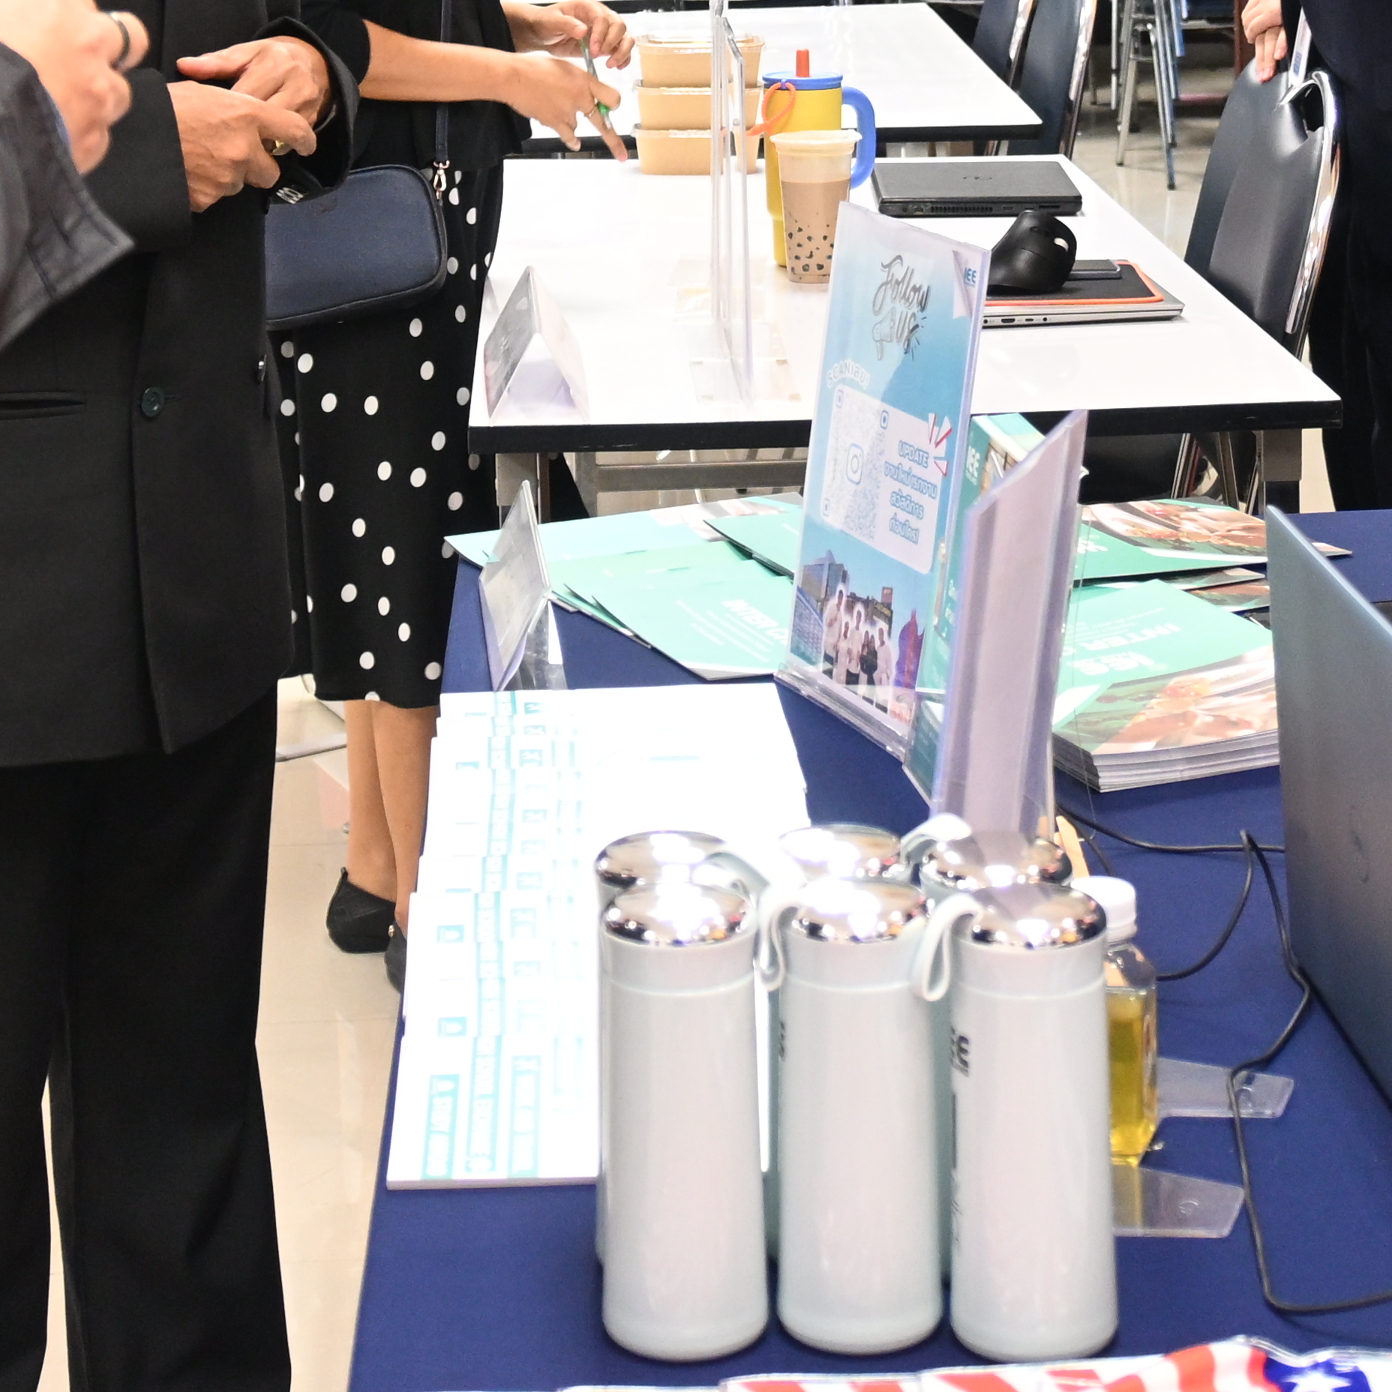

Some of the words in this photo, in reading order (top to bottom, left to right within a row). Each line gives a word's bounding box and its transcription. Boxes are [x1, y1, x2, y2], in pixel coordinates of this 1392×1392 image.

[872, 254, 932, 317] Follow
[897, 439, 930, 469] UPDATE
[1078, 622, 1182, 651] INTER
